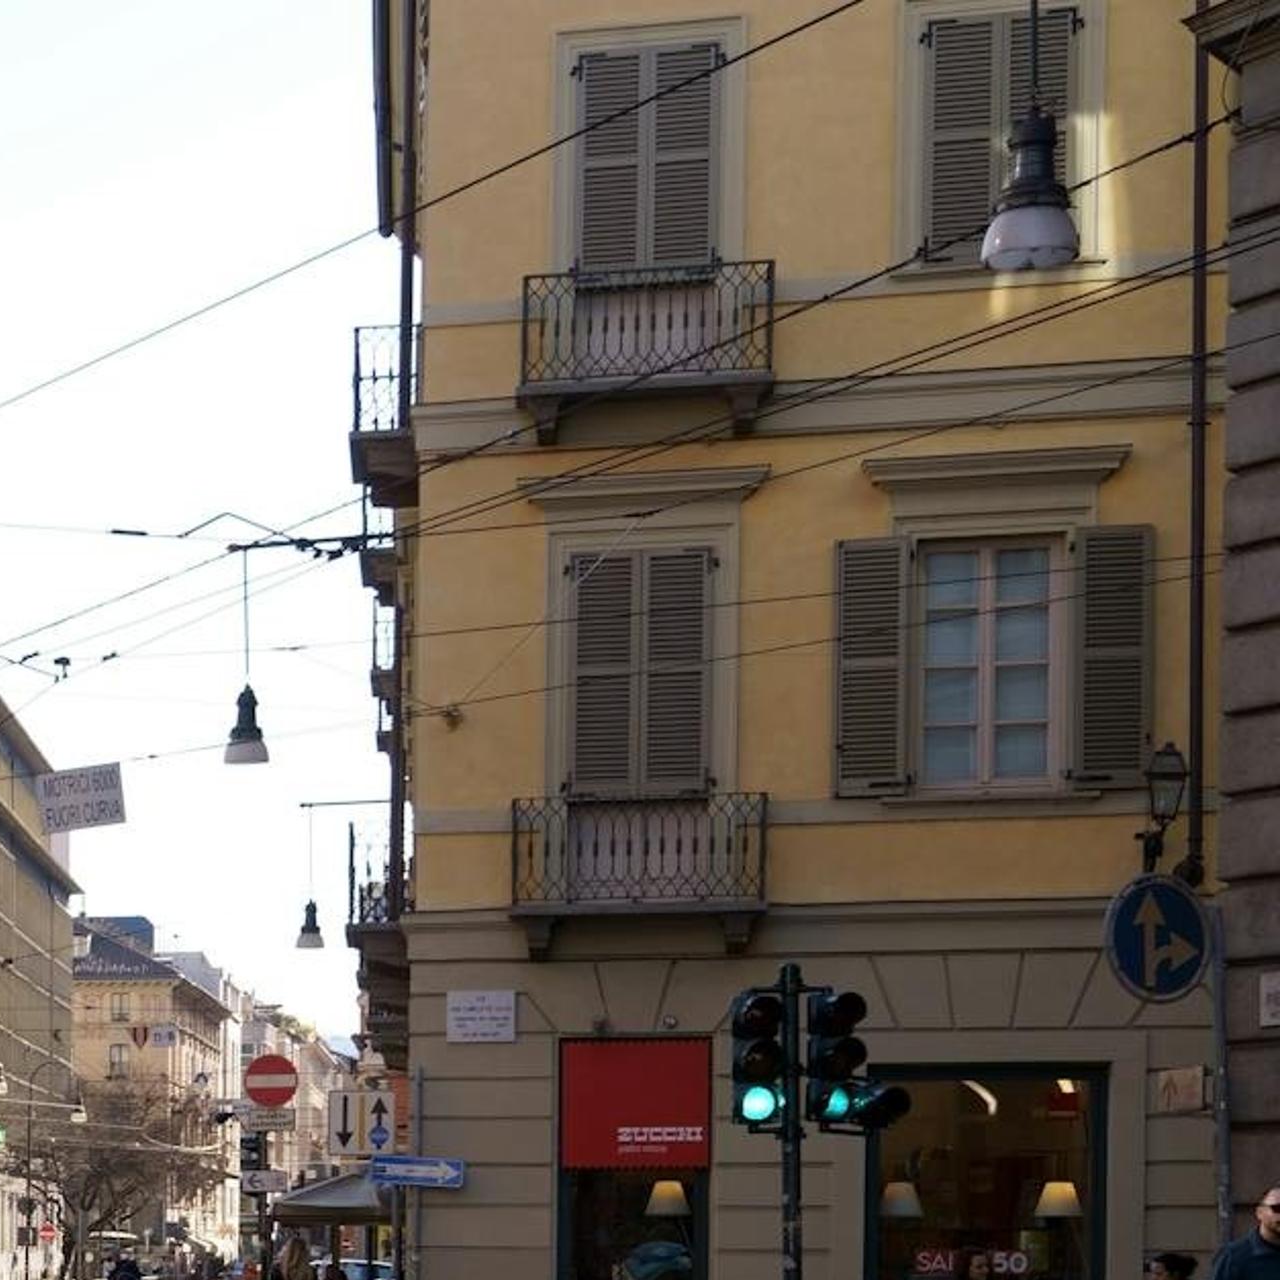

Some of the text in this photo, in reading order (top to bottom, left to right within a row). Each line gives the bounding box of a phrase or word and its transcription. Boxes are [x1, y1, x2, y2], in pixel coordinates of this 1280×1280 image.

[43, 774, 90, 799] MOTRICI
[45, 800, 121, 828] FUORI CURVA
